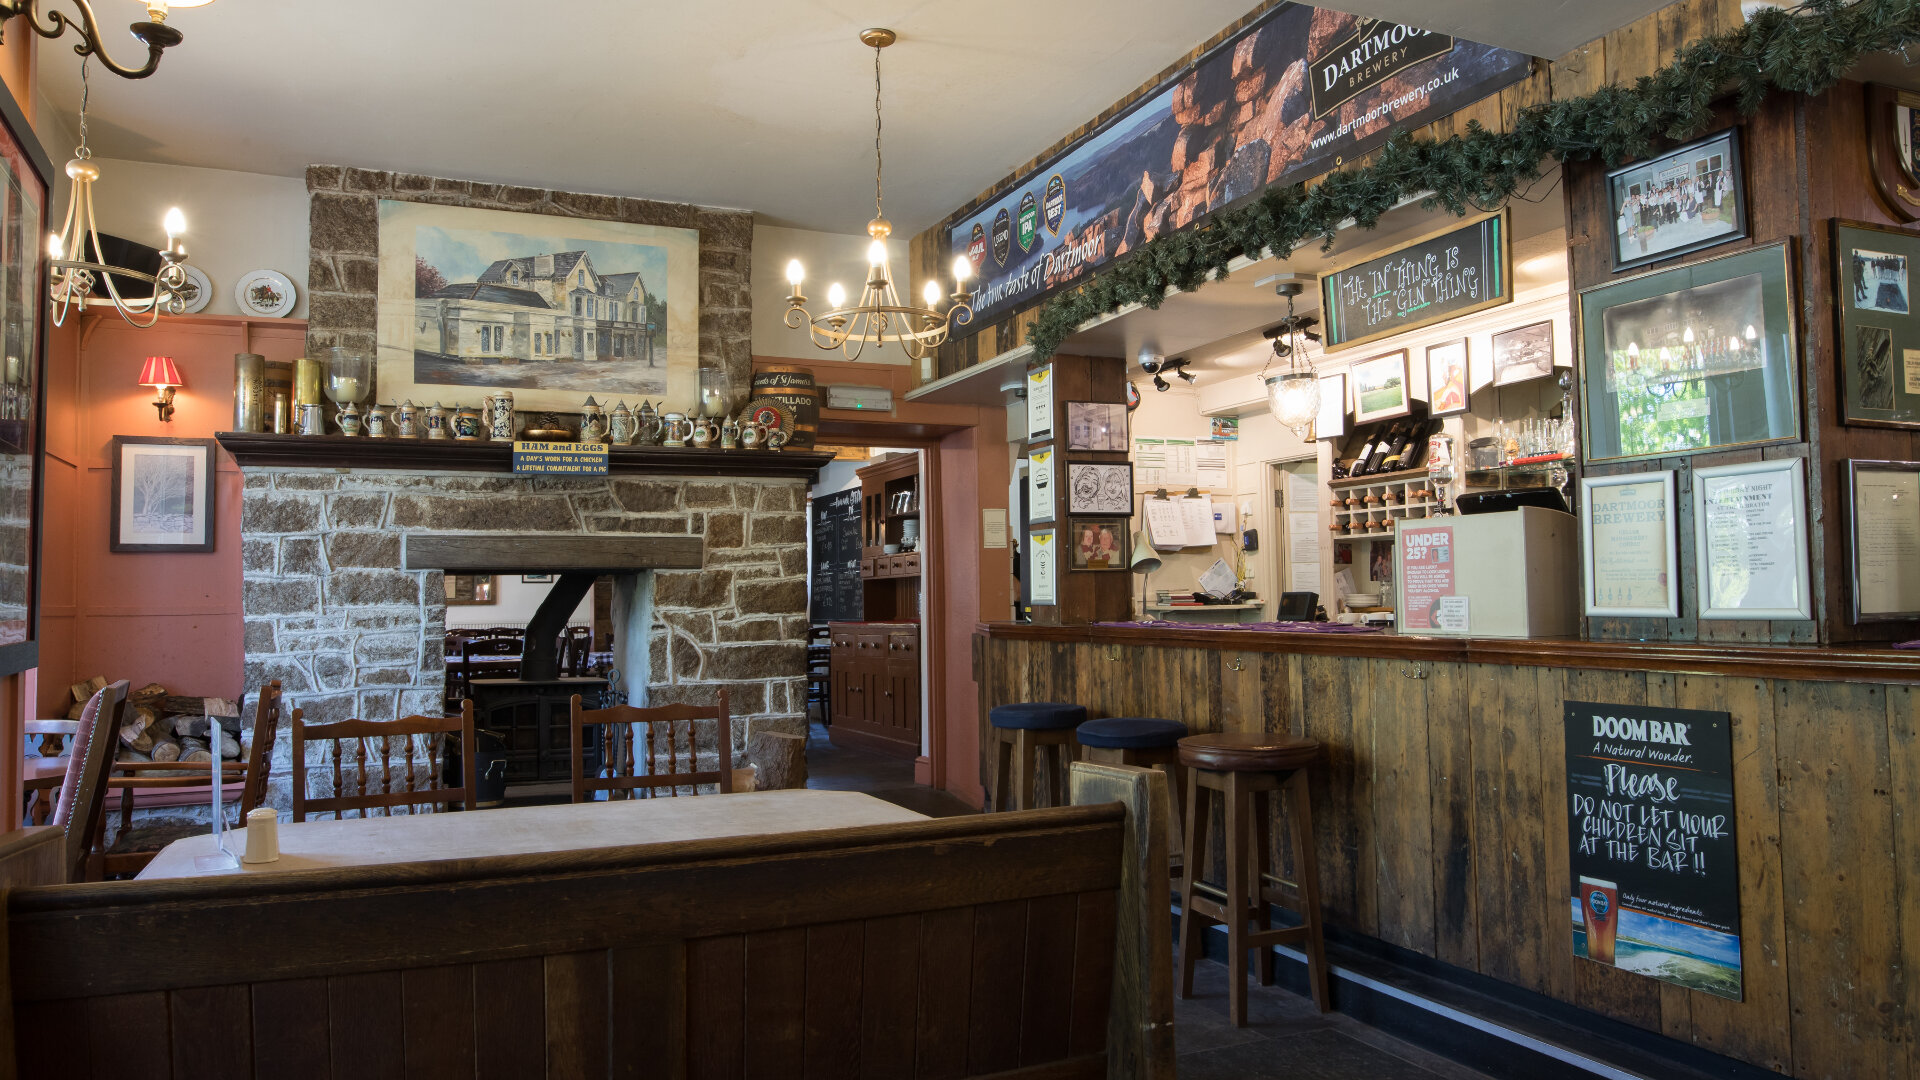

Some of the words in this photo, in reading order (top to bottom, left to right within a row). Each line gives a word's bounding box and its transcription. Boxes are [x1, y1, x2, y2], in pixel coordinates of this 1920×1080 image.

[1322, 24, 1432, 92] DARTMOO
[1350, 46, 1408, 88] BREWERY
[1310, 67, 1460, 150] www.dartmoorbrewery.co.uk
[1047, 204, 1062, 220] BEST
[994, 230, 1008, 248] LEGEND
[1022, 221, 1033, 236] IPA
[968, 242, 985, 257] JAIL
[970, 284, 986, 312] The
[988, 282, 1004, 308] true
[1006, 265, 1030, 296] taste
[1030, 256, 1044, 290] of
[1044, 234, 1103, 282] Dartmoor
[1344, 276, 1366, 306] THE
[1394, 254, 1440, 289] THING
[1446, 246, 1458, 270] IS
[1362, 298, 1392, 326] THE
[1431, 266, 1478, 304] THING
[764, 396, 812, 406] TILLADO
[522, 442, 549, 450] HAM
[1752, 484, 1772, 492] NIGHT
[1593, 510, 1664, 524] BREWERY
[1594, 499, 1664, 512] DARTMOOR
[1406, 532, 1449, 547] UNDER
[1406, 546, 1428, 560] 25?
[1592, 716, 1648, 742] DOOM
[1650, 720, 1692, 746] BAR
[1593, 742, 1600, 753] A
[1604, 744, 1646, 758] Natural
[1649, 748, 1694, 764] Wonder.
[1604, 764, 1680, 802] Please
[1574, 794, 1594, 816] DO
[1600, 800, 1634, 822] NOT
[1641, 806, 1674, 828] LET
[1680, 810, 1728, 838] YOUR
[1583, 816, 1661, 846] CHILDREN
[1666, 828, 1699, 853] SIT
[1580, 834, 1600, 854] AT
[1606, 840, 1638, 862] THE
[1622, 892, 1634, 904] Only
[1636, 895, 1648, 904] four
[1648, 898, 1670, 908] natural
[1670, 904, 1705, 917] ingredients.
